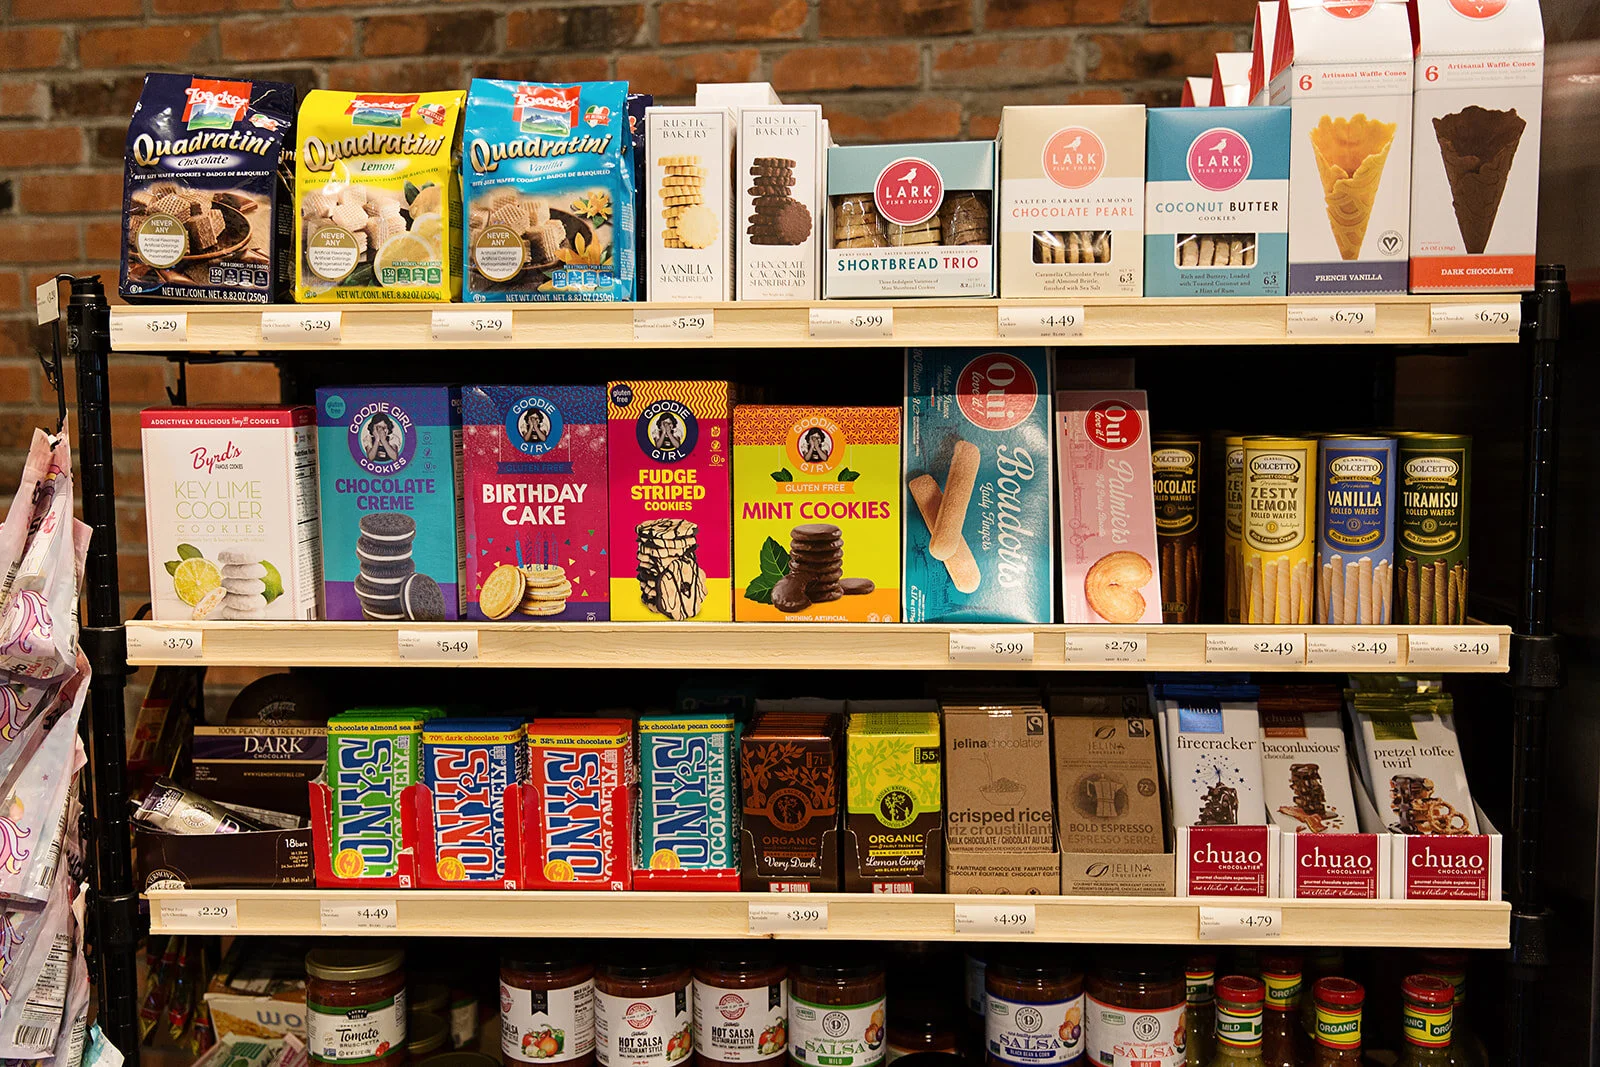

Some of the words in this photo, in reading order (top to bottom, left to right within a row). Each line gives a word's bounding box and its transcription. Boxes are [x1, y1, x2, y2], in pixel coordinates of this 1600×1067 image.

[1425, 66, 1439, 82] 6
[1447, 62, 1485, 70] Artisanal
[1486, 61, 1511, 69] Waffle
[1512, 60, 1536, 68] Cones
[1299, 74, 1313, 91] 6
[1322, 71, 1358, 79] Artisanal
[1359, 69, 1383, 77] Waffle
[133, 131, 276, 167] Quadratini
[303, 131, 445, 172] Quadratini
[470, 133, 612, 173] Quadratini
[1052, 153, 1096, 165] LARK
[1197, 155, 1241, 167] LARK
[361, 162, 396, 172] Lemon
[529, 161, 564, 172] Vanilla
[885, 186, 933, 199] LARK
[1012, 208, 1089, 218] CHOCOLATE
[1096, 207, 1134, 217] PEARL
[1155, 202, 1224, 213] COCONUT
[1229, 201, 1279, 212] BUTTER
[151, 219, 173, 227] NEVER
[321, 232, 345, 240] NEVER
[325, 239, 340, 247] ANY
[660, 264, 713, 275] VANILLA
[837, 258, 939, 272] SHORTBREAD
[943, 256, 979, 269] TRIO
[383, 269, 395, 277] 150
[1315, 274, 1347, 282] FRENCH
[1349, 273, 1383, 281] VANILLA
[1441, 268, 1465, 276] DARK
[1465, 267, 1514, 275] CHOCOLATE
[660, 275, 714, 283] SHORTBREAD
[750, 279, 806, 287] SHORTBREAD
[849, 315, 883, 327] $5.99
[1040, 315, 1075, 327] $4.49
[1329, 311, 1364, 324] $6.79
[1474, 309, 1510, 324] $6.79
[146, 320, 177, 332] $5.29
[300, 320, 331, 331] $5.29
[470, 319, 503, 331] $5.29
[672, 317, 705, 329] $5.29
[512, 398, 556, 415] GOODIE
[644, 401, 691, 420] GOODIE
[793, 417, 839, 434] GOODIE
[1105, 405, 1127, 444] Oui
[520, 442, 552, 453] GIRL
[651, 449, 686, 461] GIRL
[360, 457, 407, 473] COOKIES
[799, 462, 833, 473] GIRL
[1253, 461, 1296, 470] DOLCETTO
[1334, 463, 1379, 472] DOLCETTO
[1408, 464, 1454, 473] DOLCETTO
[639, 469, 697, 484] FUDGE
[174, 480, 212, 499] KEY
[216, 480, 262, 499] LIME
[335, 478, 436, 494] CHOCOLATE
[785, 484, 820, 492] GLUTEN
[822, 483, 846, 492] FREE
[482, 483, 588, 504] BIRTHDAY
[631, 485, 706, 500] STRIPED
[1250, 487, 1298, 499] ZESTY
[1327, 490, 1382, 507] VANILLA
[356, 495, 414, 510] CREME
[1251, 500, 1297, 511] LEMON
[1403, 491, 1458, 508] TIRAMISU
[175, 502, 262, 520] COOLER
[644, 501, 693, 511] COOKIES
[742, 502, 793, 520] MINT
[799, 501, 891, 519] COOKIES
[1331, 507, 1353, 515] ROLLED
[1354, 507, 1379, 515] WAFERS
[1405, 508, 1428, 516] ROLLED
[1429, 508, 1455, 516] WAFERS
[502, 505, 566, 525] CAKE
[1250, 511, 1271, 519] ROLLED
[1272, 512, 1297, 520] WAFERS
[177, 525, 265, 534] COOKIES
[163, 638, 193, 649] $3.79
[436, 640, 469, 653] $5.49
[990, 643, 1023, 654] $5.99
[1105, 641, 1138, 652] $2.79
[1253, 641, 1293, 655] $2.49
[1351, 641, 1388, 654] $2.49
[1453, 642, 1490, 655] $2.49
[243, 736, 304, 754] DARK
[556, 737, 575, 745] milk
[1177, 736, 1253, 750] firecracker
[1262, 742, 1338, 753] baconluxious
[1373, 746, 1417, 760] pretzel
[1419, 745, 1455, 757] toffee
[1382, 757, 1412, 769] twirl
[949, 808, 1015, 825] crisped
[1019, 808, 1053, 822] rice
[1069, 823, 1099, 833] BOLD
[1101, 823, 1153, 833] ESPRESSO
[762, 836, 817, 846] ORGANIC
[868, 834, 923, 844] ORGANIC
[1193, 842, 1262, 866] chuao
[1300, 847, 1371, 869] chuao
[1411, 847, 1483, 869] chuao
[764, 856, 789, 871] Very
[790, 856, 817, 869] Dark
[865, 855, 898, 866] Lemon
[1111, 863, 1152, 873] JELINA
[197, 906, 228, 918] $2.29
[357, 908, 389, 920] $4.49
[787, 910, 819, 922] $3.99
[993, 913, 1027, 926] $4.99
[1239, 915, 1273, 928] $4.79
[712, 1026, 727, 1038] HOT
[729, 1026, 755, 1038] SALSA
[1222, 1023, 1241, 1031] MILD
[1319, 1022, 1357, 1033] ORGANIC
[335, 1028, 379, 1042] Tomato
[618, 1036, 635, 1047] HOT
[636, 1036, 663, 1047] SALSA
[804, 1039, 866, 1055] SALSA
[1000, 1033, 1061, 1050] SALSA
[1113, 1045, 1175, 1059] SALSA
